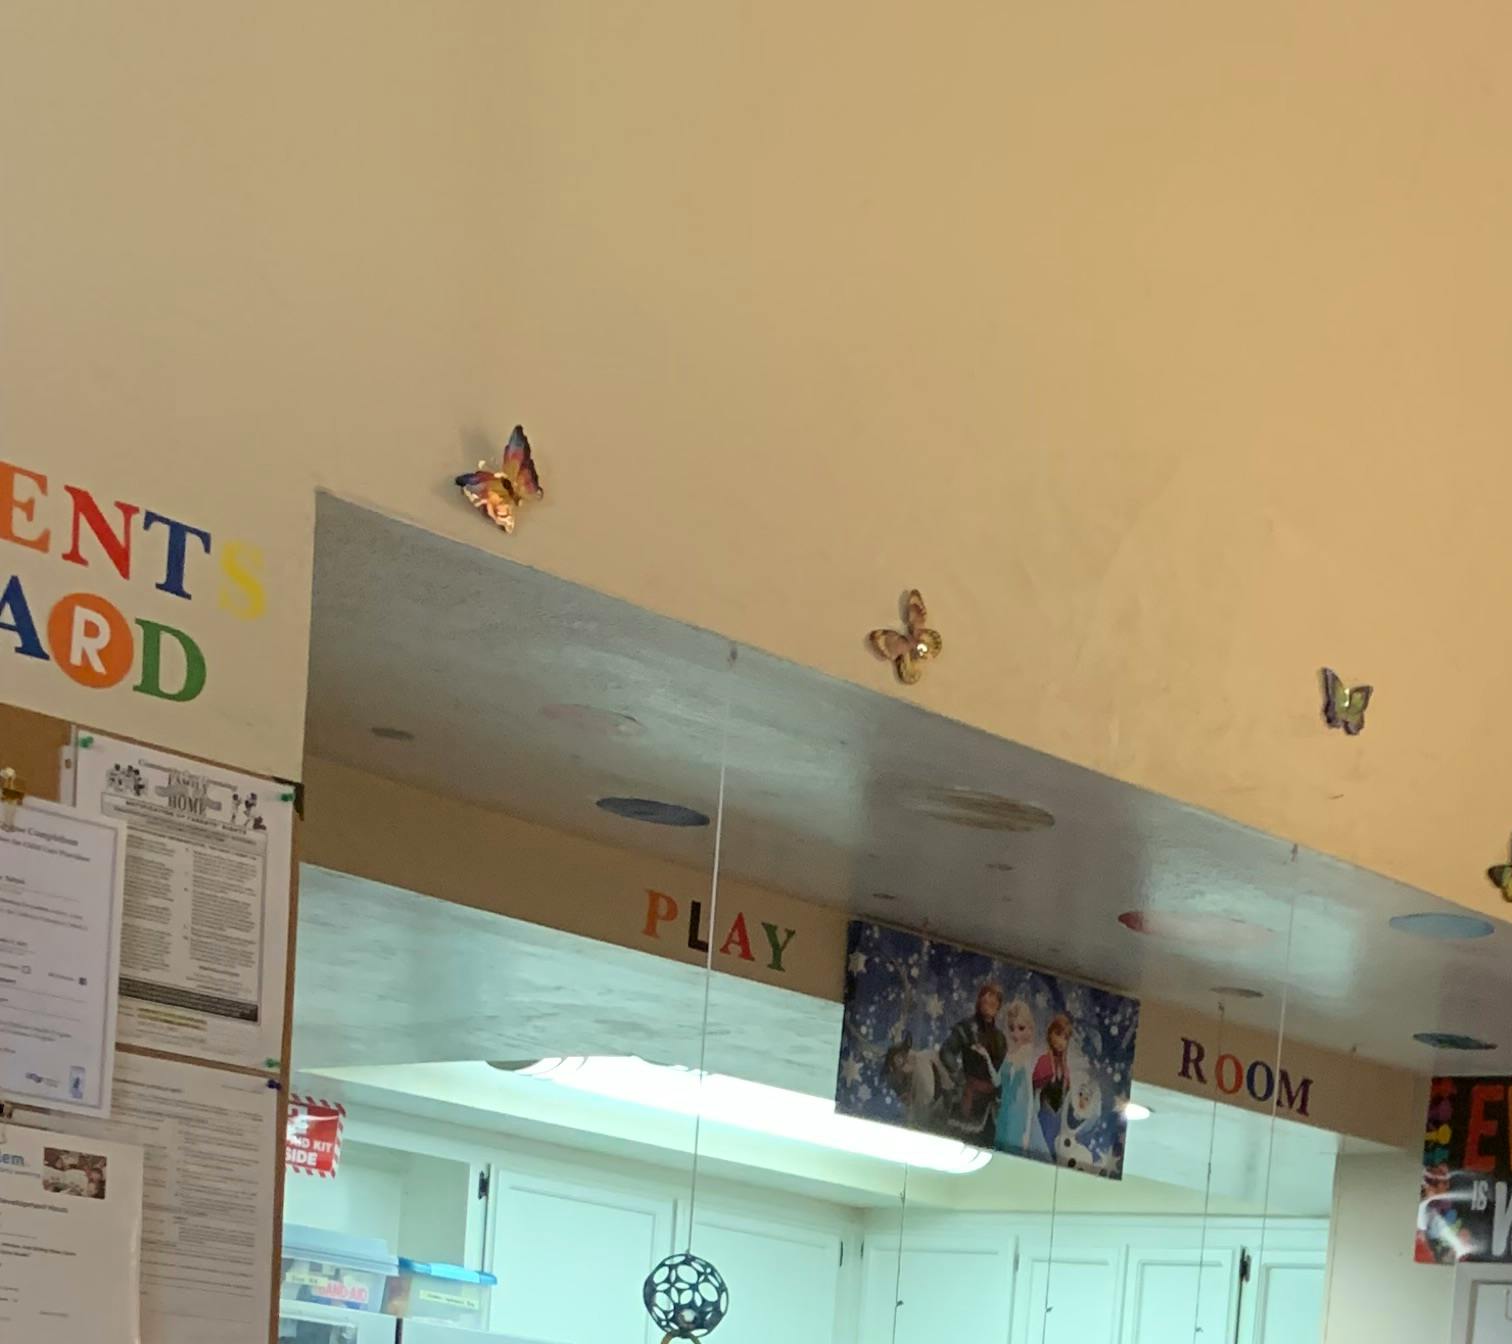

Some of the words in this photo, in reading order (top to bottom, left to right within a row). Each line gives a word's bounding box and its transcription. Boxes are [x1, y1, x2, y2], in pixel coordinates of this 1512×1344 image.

[0, 460, 268, 622] ENTS
[0, 575, 207, 702] ARD
[641, 888, 796, 972] PLAY
[1178, 1037, 1314, 1117] ROOM
[0, 1153, 25, 1166] em
[1470, 1180, 1490, 1212] IS
